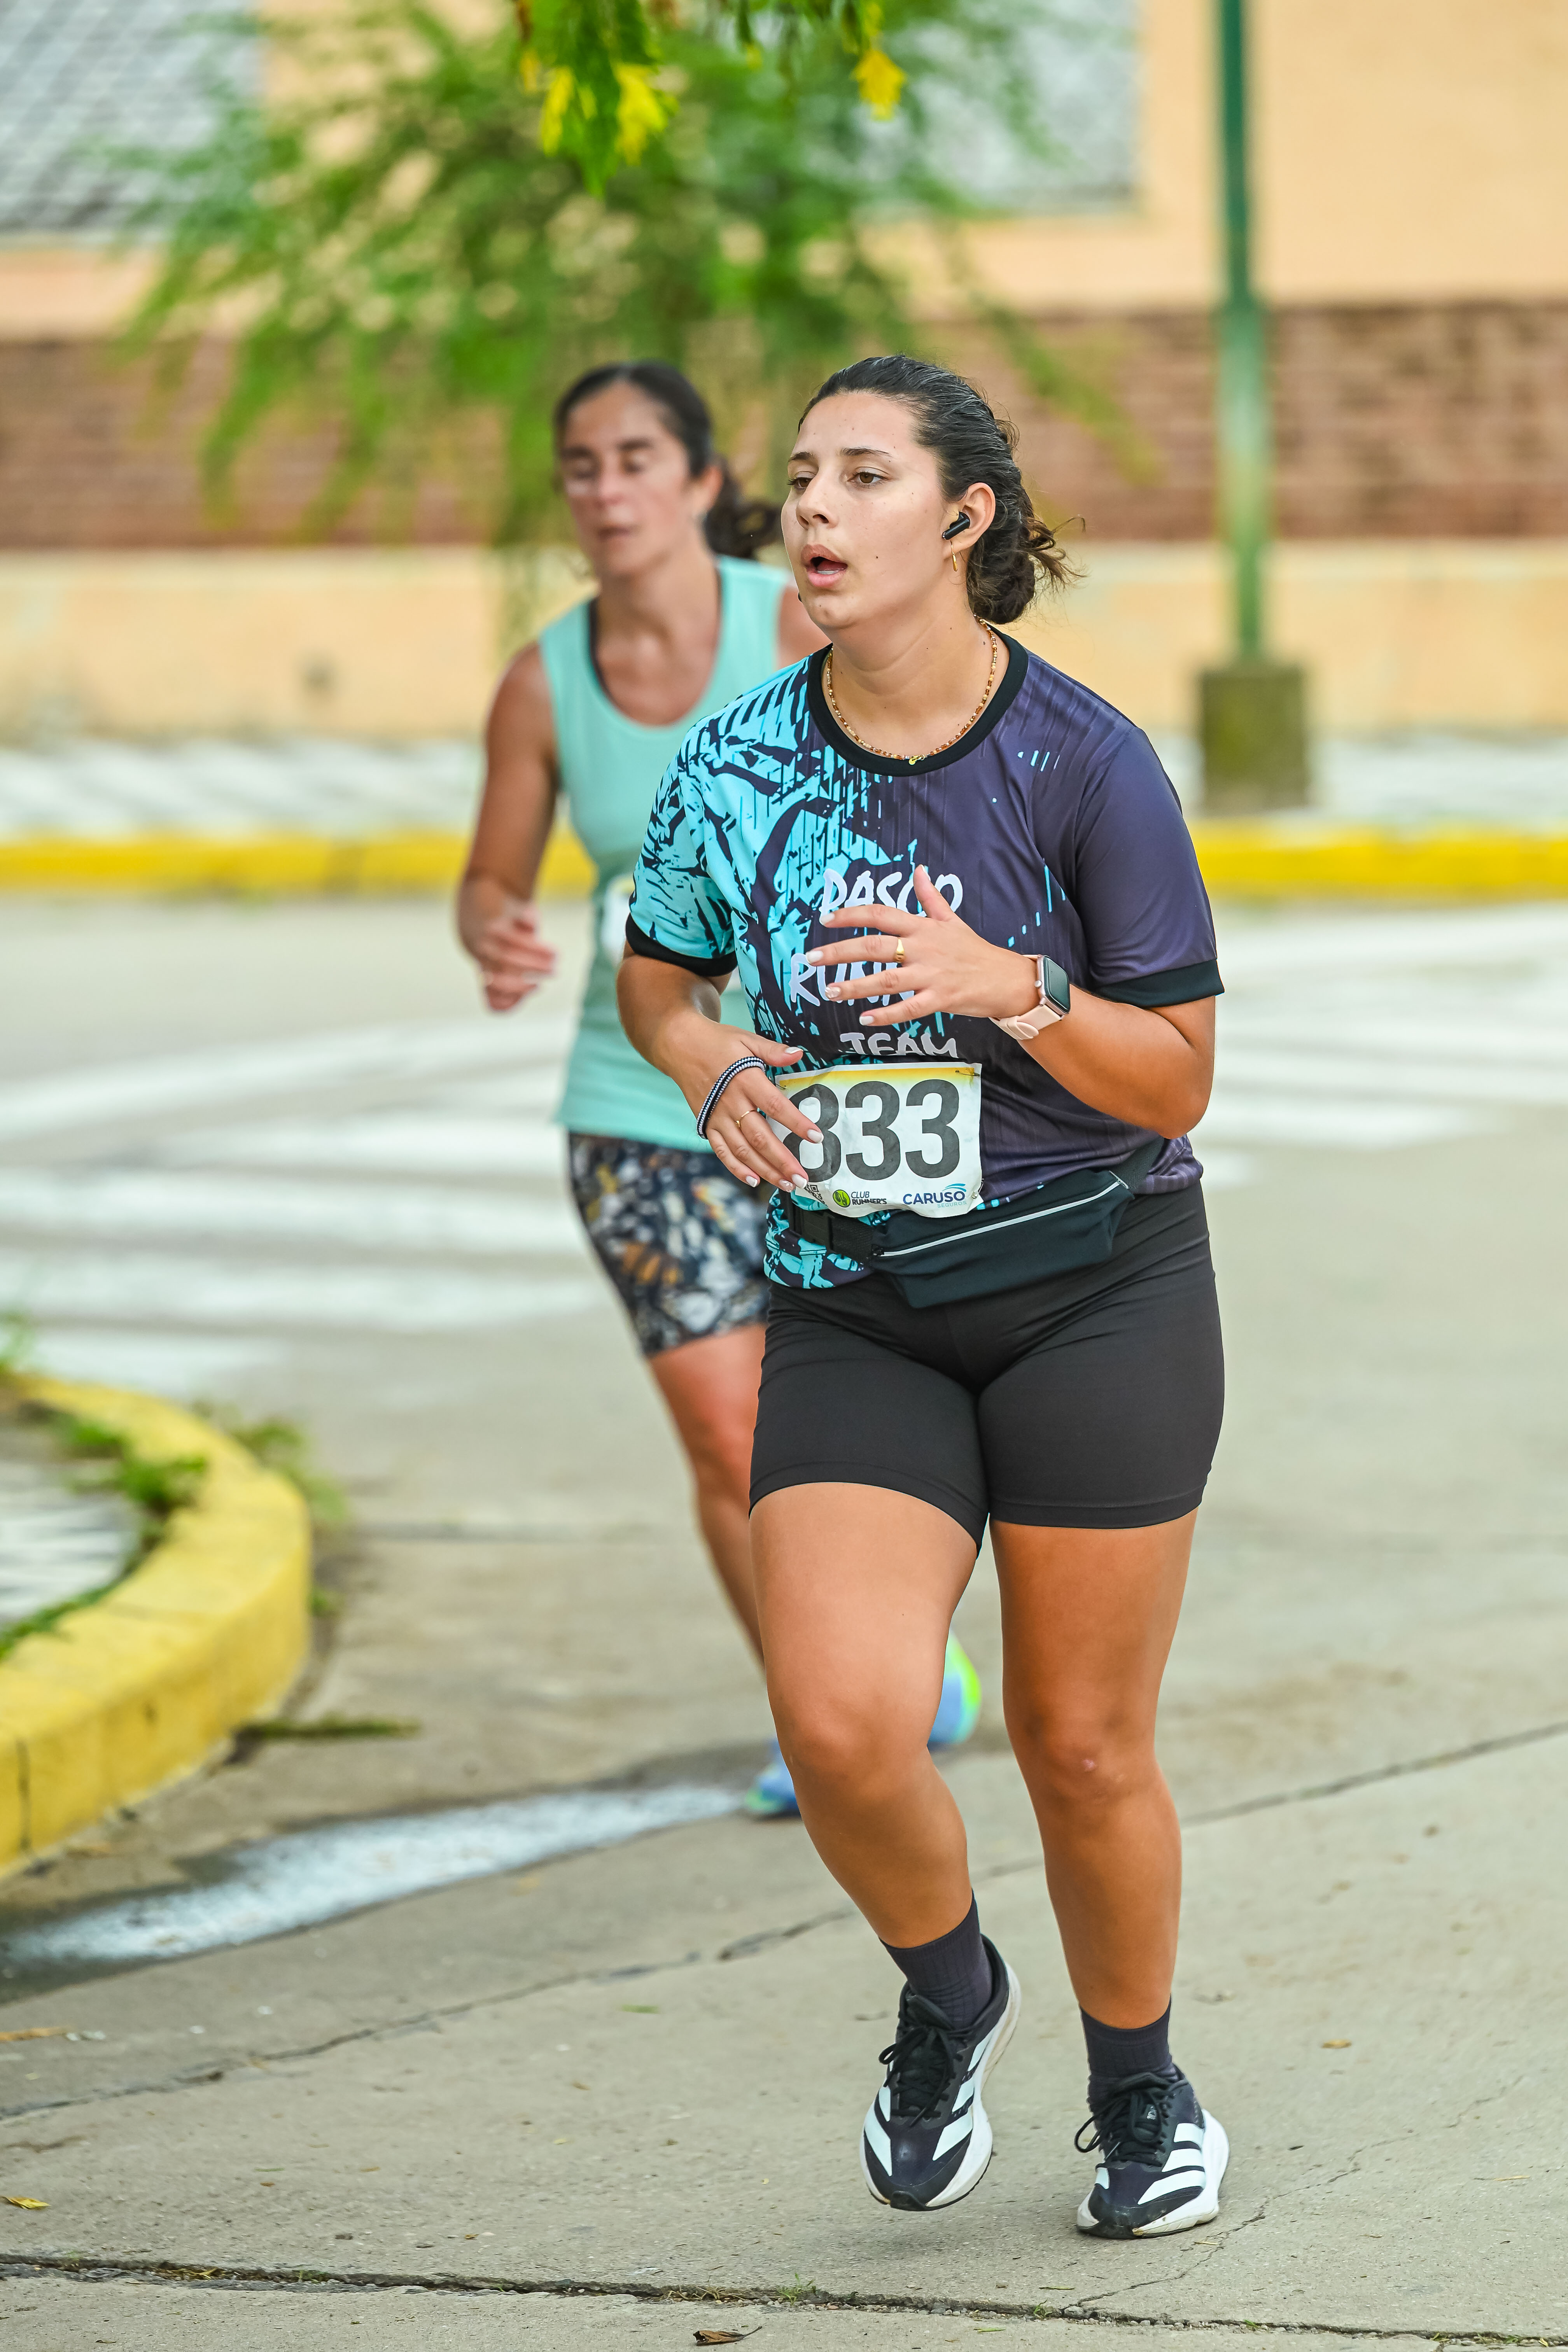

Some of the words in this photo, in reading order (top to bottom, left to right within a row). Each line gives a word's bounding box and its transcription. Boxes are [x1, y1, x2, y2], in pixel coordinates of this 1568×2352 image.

[840, 1032, 959, 1059] TEAM
[782, 1079, 960, 1183] 833
[903, 1191, 965, 1205] CARUSO
